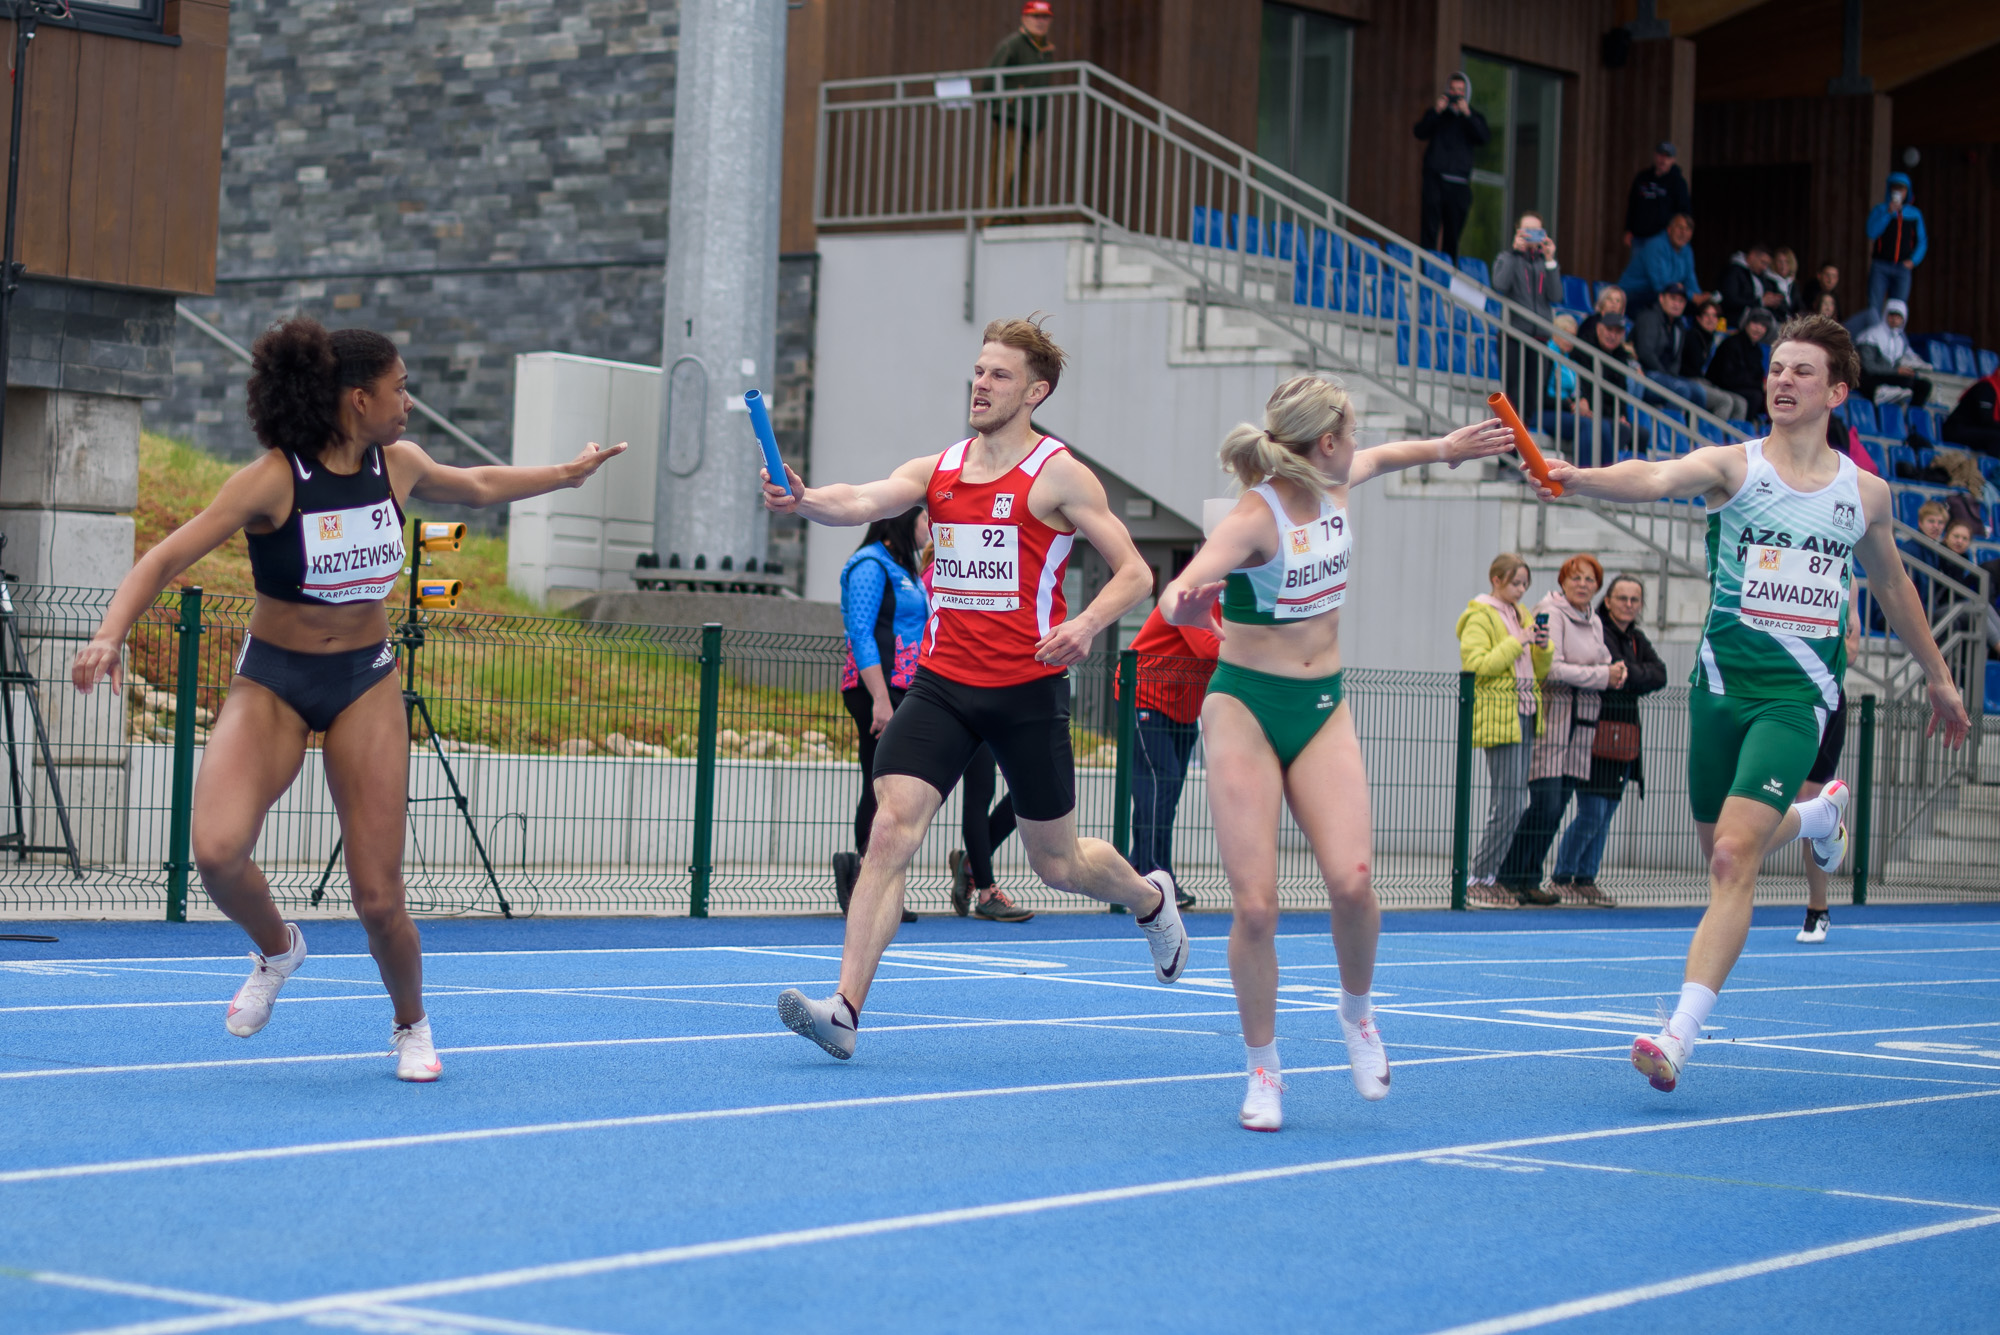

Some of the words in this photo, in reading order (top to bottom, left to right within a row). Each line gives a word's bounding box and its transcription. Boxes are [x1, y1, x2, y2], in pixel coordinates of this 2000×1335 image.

[371, 505, 391, 530] 91
[982, 529, 1005, 547] 92
[1739, 528, 1792, 548] AZS
[312, 540, 404, 574] KRZYŻEWSKA
[1808, 555, 1833, 575] 87
[936, 558, 1013, 580] STOLARSKI
[318, 587, 362, 598] KARPACZ
[942, 596, 974, 605] KARPACZ
[1746, 580, 1839, 609] ZAWADZKI
[1290, 599, 1325, 612] KARPACZ
[1752, 617, 1793, 630] KARPACZ
[1795, 624, 1816, 633] 2022
[372, 654, 393, 668] adida
